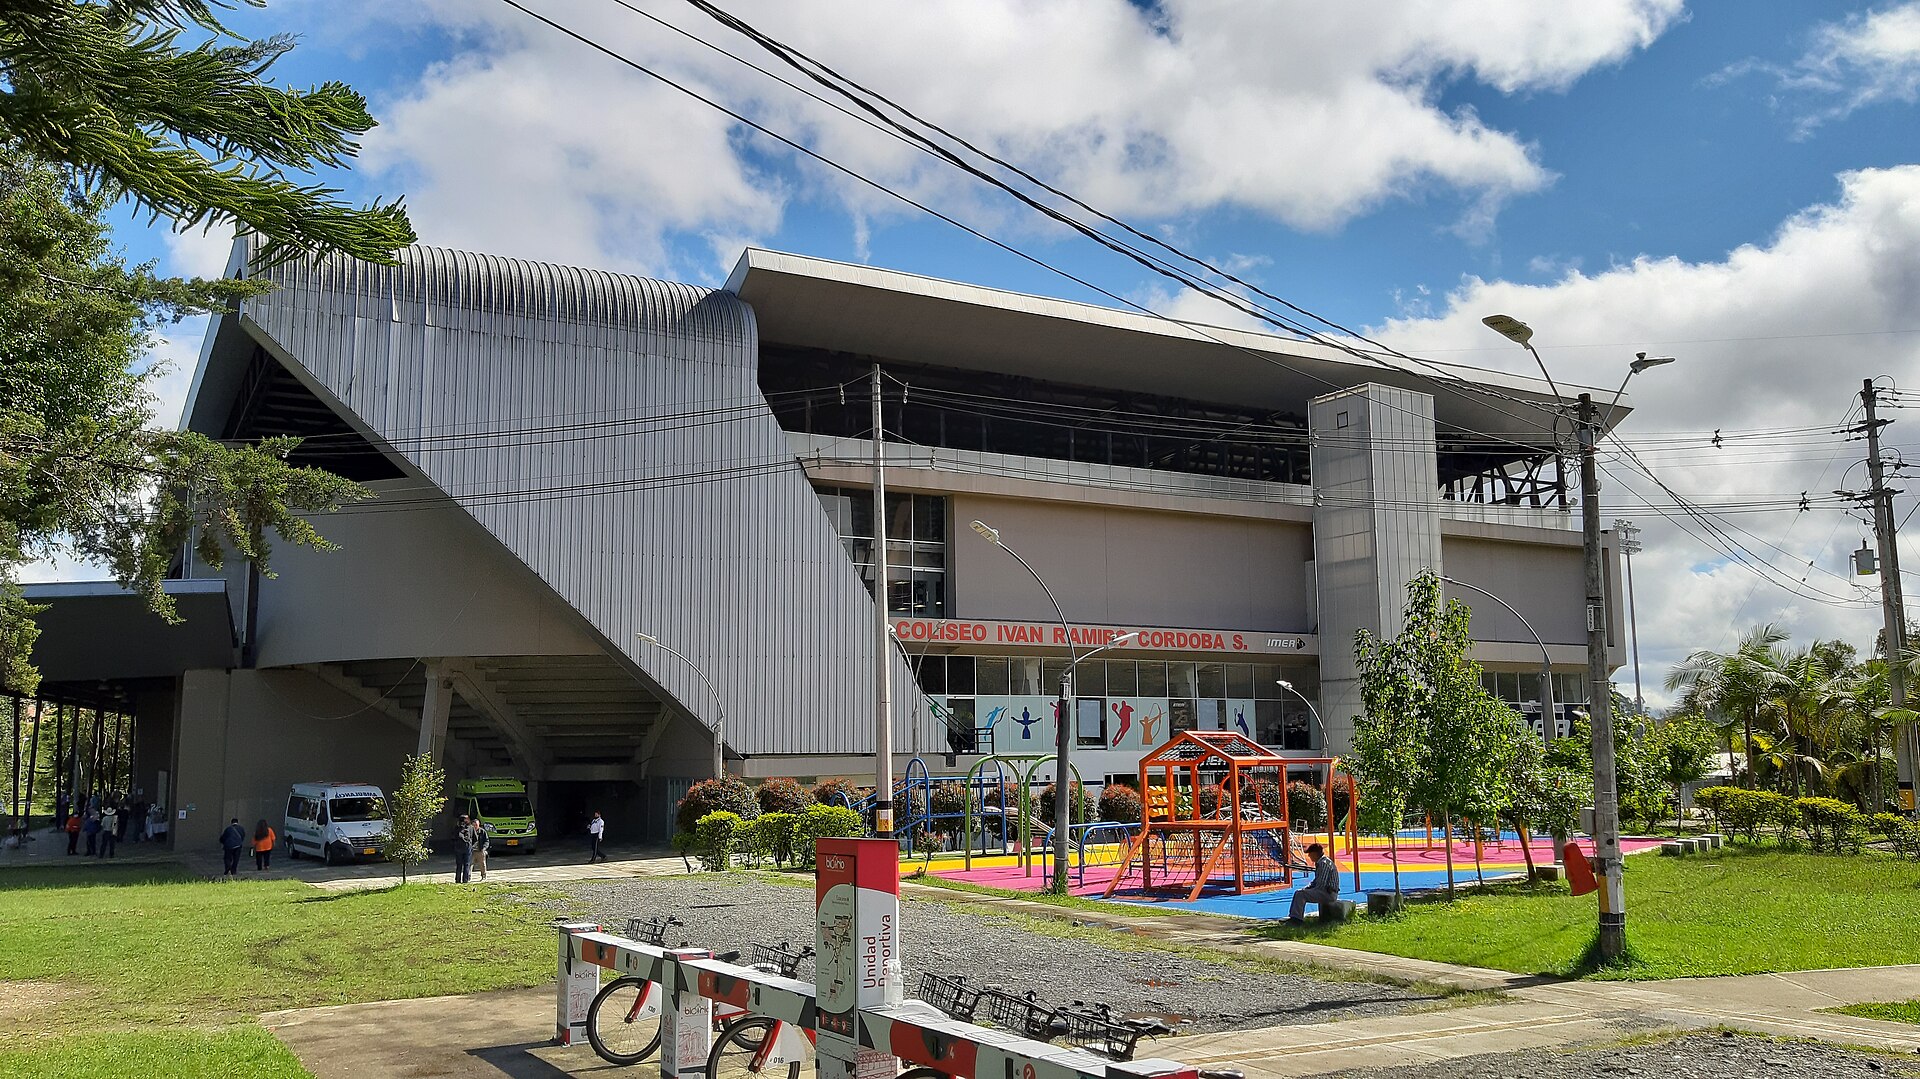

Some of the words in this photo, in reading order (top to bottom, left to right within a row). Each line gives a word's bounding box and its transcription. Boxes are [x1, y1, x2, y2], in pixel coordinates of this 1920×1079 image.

[896, 620, 987, 641] COLISEO
[997, 624, 1043, 643] IVAN
[1138, 630, 1226, 650] CORDOBA
[1232, 634, 1248, 650] S.
[1267, 638, 1296, 649] IMER
[863, 936, 876, 989] Unidad
